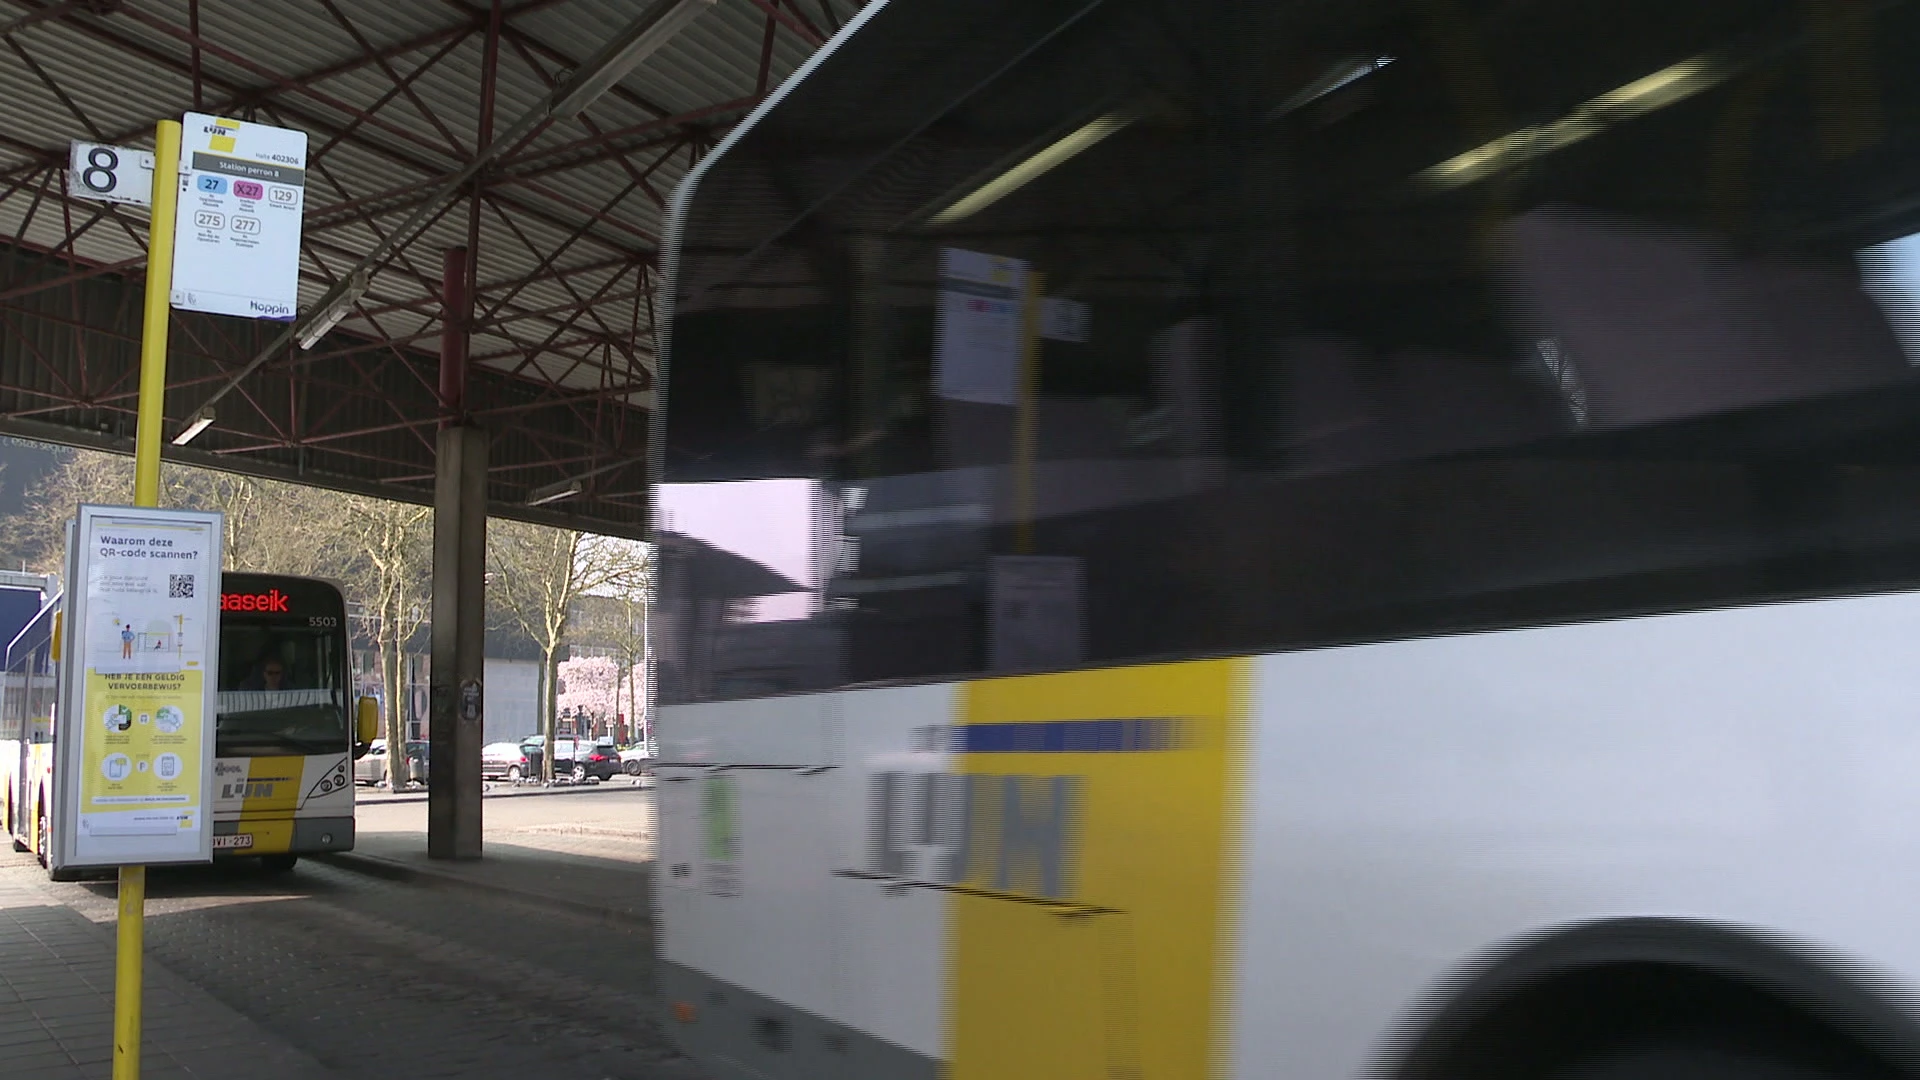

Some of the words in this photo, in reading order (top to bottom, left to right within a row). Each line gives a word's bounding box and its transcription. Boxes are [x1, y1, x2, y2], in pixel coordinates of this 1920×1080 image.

[271, 154, 299, 165] 402306
[82, 148, 119, 193] 8
[219, 161, 247, 173] Station
[247, 166, 273, 177] perron
[204, 179, 219, 190] 27
[237, 183, 259, 196] X27
[273, 190, 292, 201] 129
[198, 213, 221, 227] 275
[235, 219, 255, 231] 277
[250, 300, 289, 315] Hoppin
[100, 535, 146, 547] Waarom
[148, 537, 173, 547] deze
[99, 547, 147, 558] QR-code
[149, 549, 198, 560] scannen?
[308, 616, 337, 628] 5503
[124, 673, 133, 681] JE
[135, 673, 152, 681] EEN
[154, 673, 185, 681] GELDIG
[108, 682, 182, 690] VERVOERBEWIJS?
